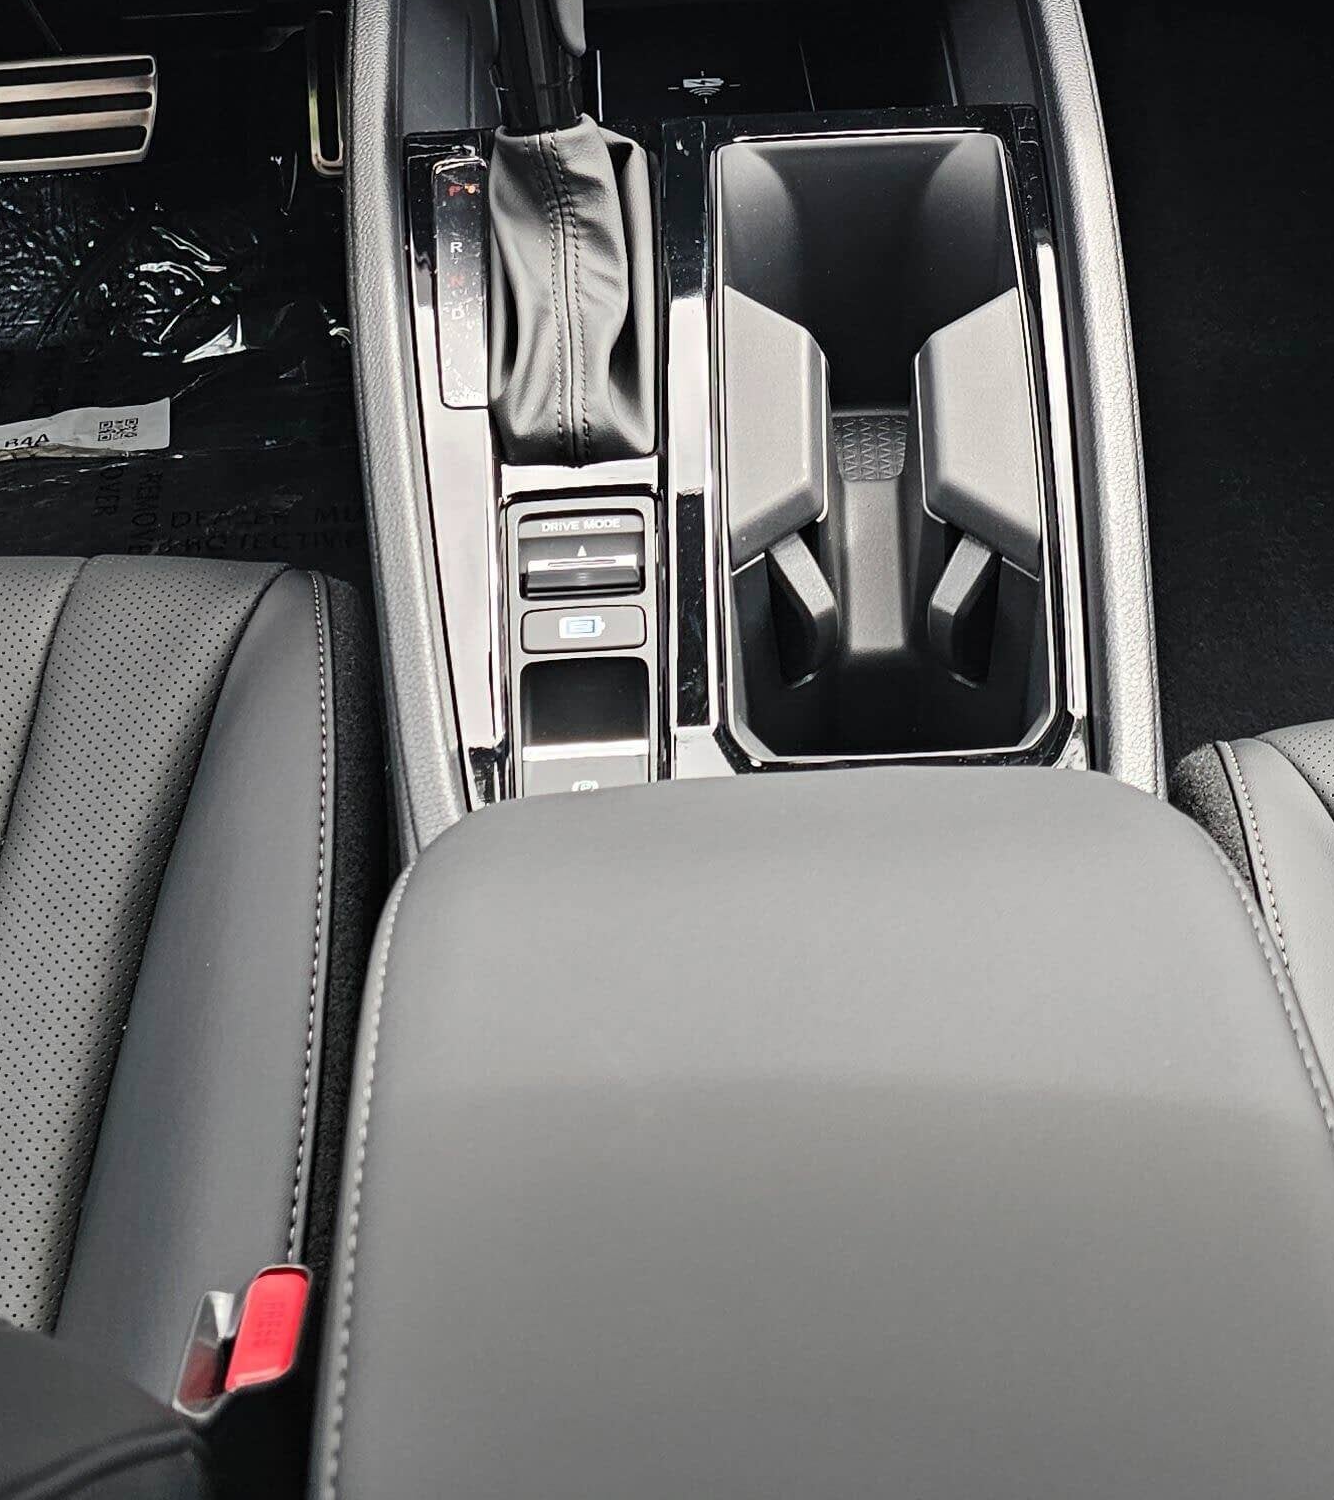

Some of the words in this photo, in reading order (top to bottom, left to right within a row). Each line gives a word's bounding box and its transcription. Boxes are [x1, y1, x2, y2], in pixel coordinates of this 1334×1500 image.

[450, 242, 463, 253] R
[451, 308, 465, 320] D
[541, 520, 580, 533] DRIVE
[583, 517, 621, 530] MODE
